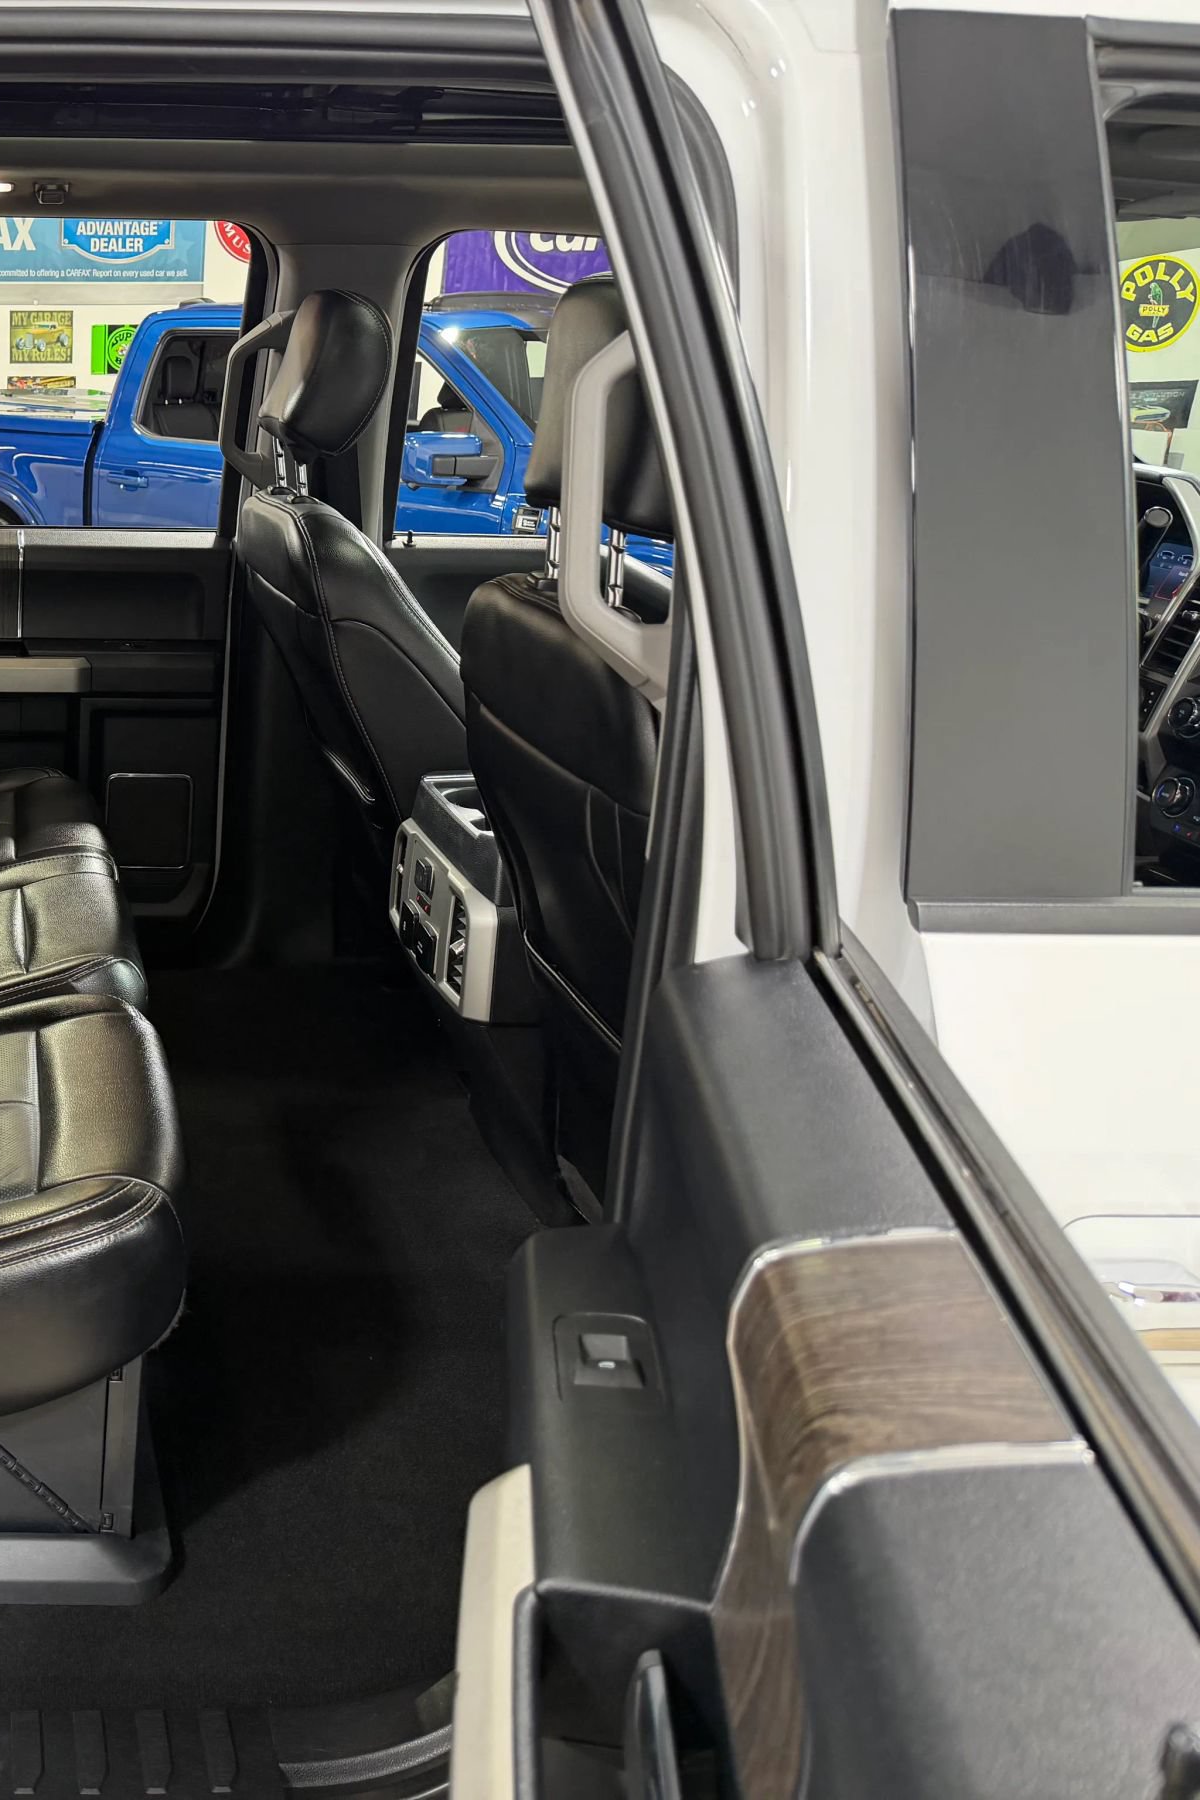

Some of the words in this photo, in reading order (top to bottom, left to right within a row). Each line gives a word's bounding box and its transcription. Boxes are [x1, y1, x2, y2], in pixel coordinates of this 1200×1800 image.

[76, 221, 158, 236] ADVANTAGE
[90, 237, 144, 253] DEALER
[30, 269, 36, 277] to
[36, 268, 60, 278] offering
[92, 268, 112, 278] Report
[122, 270, 139, 278] every
[140, 268, 154, 277] used
[1121, 262, 1195, 303] POLLY
[1142, 306, 1166, 314] POLLY
[11, 311, 29, 326] MY
[30, 311, 72, 325] GARAGE
[1126, 323, 1175, 342] GAS
[11, 348, 29, 362] MY
[31, 347, 70, 362] RULES!
